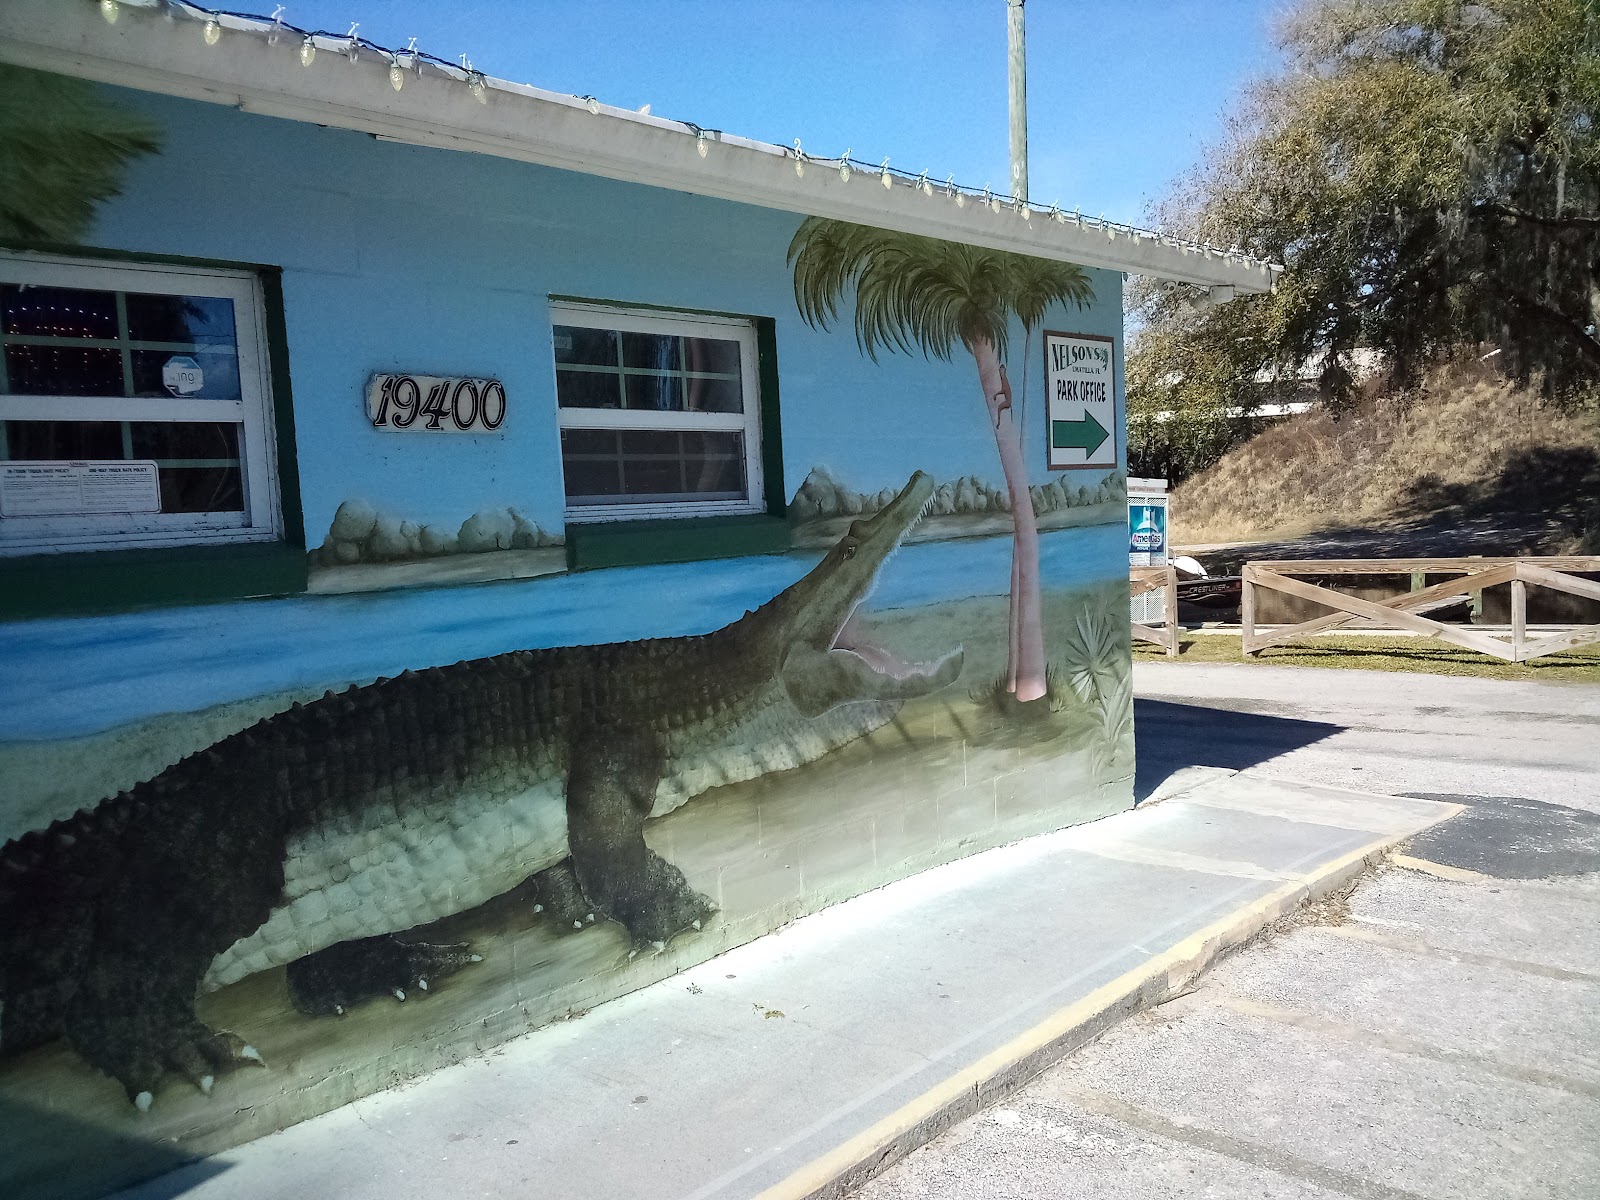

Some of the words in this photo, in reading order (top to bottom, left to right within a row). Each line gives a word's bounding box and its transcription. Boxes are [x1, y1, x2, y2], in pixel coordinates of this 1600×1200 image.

[172, 372, 195, 385] ing
[1057, 379, 1078, 401] PARK
[1080, 380, 1106, 402] OFFICE
[373, 375, 506, 430] 19400
